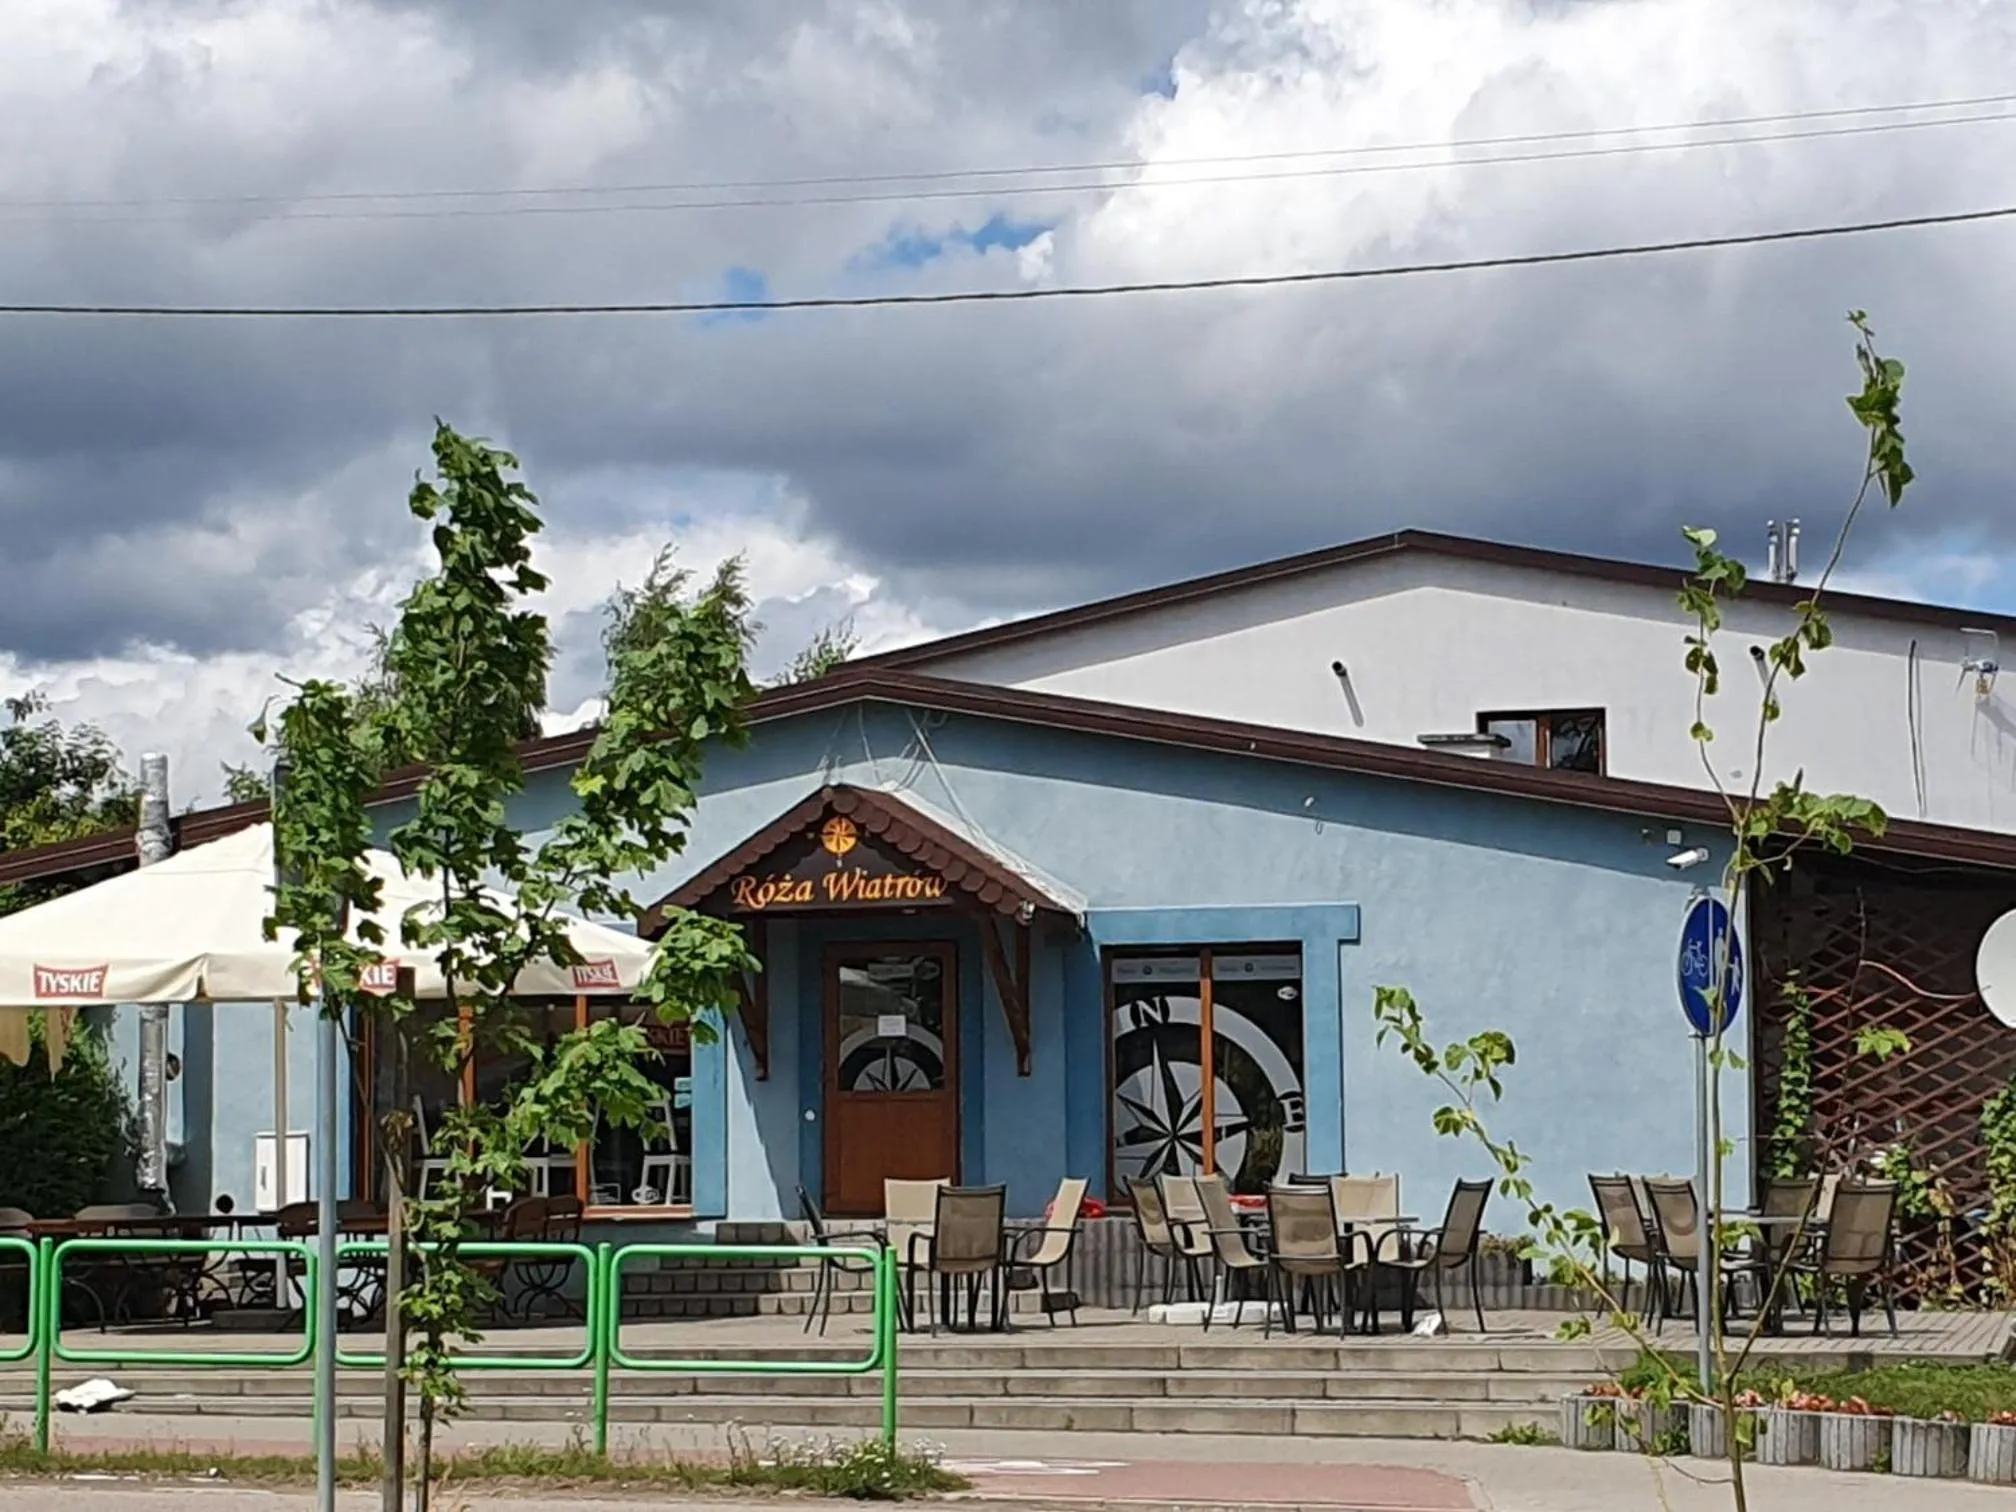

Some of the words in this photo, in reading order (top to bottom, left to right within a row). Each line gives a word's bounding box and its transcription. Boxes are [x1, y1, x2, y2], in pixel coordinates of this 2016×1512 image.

[731, 873, 816, 909] Róża
[822, 866, 948, 901] Wiatrów
[37, 970, 103, 993] TYSKIE
[1136, 996, 1165, 1027] N
